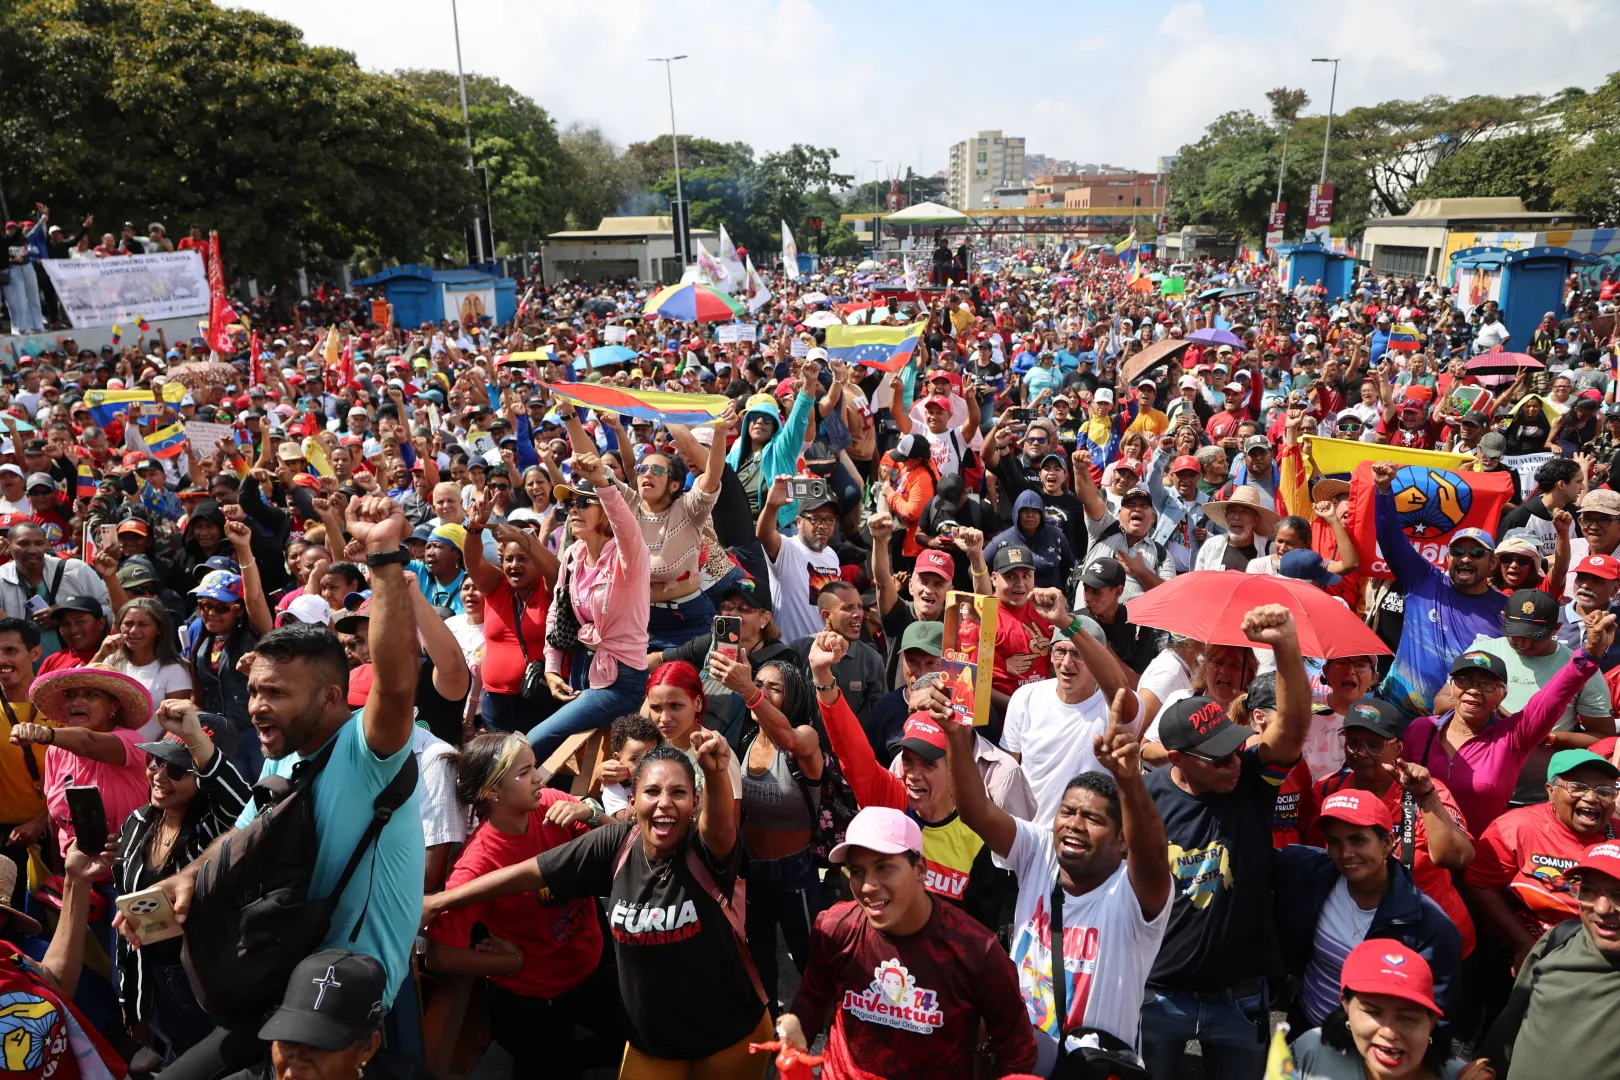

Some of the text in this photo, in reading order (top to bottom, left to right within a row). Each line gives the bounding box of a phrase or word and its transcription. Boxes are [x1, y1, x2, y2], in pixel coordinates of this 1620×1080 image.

[1404, 808, 1412, 844] JACOBS
[1176, 847, 1224, 866] NUESTRA
[610, 899, 699, 934] FURIA
[617, 898, 650, 909] SOMOS
[843, 992, 942, 1026] Juventud
[913, 990, 934, 1012] 14
[852, 1007, 888, 1024] Angostura
[901, 1021, 931, 1033] Orinoco
